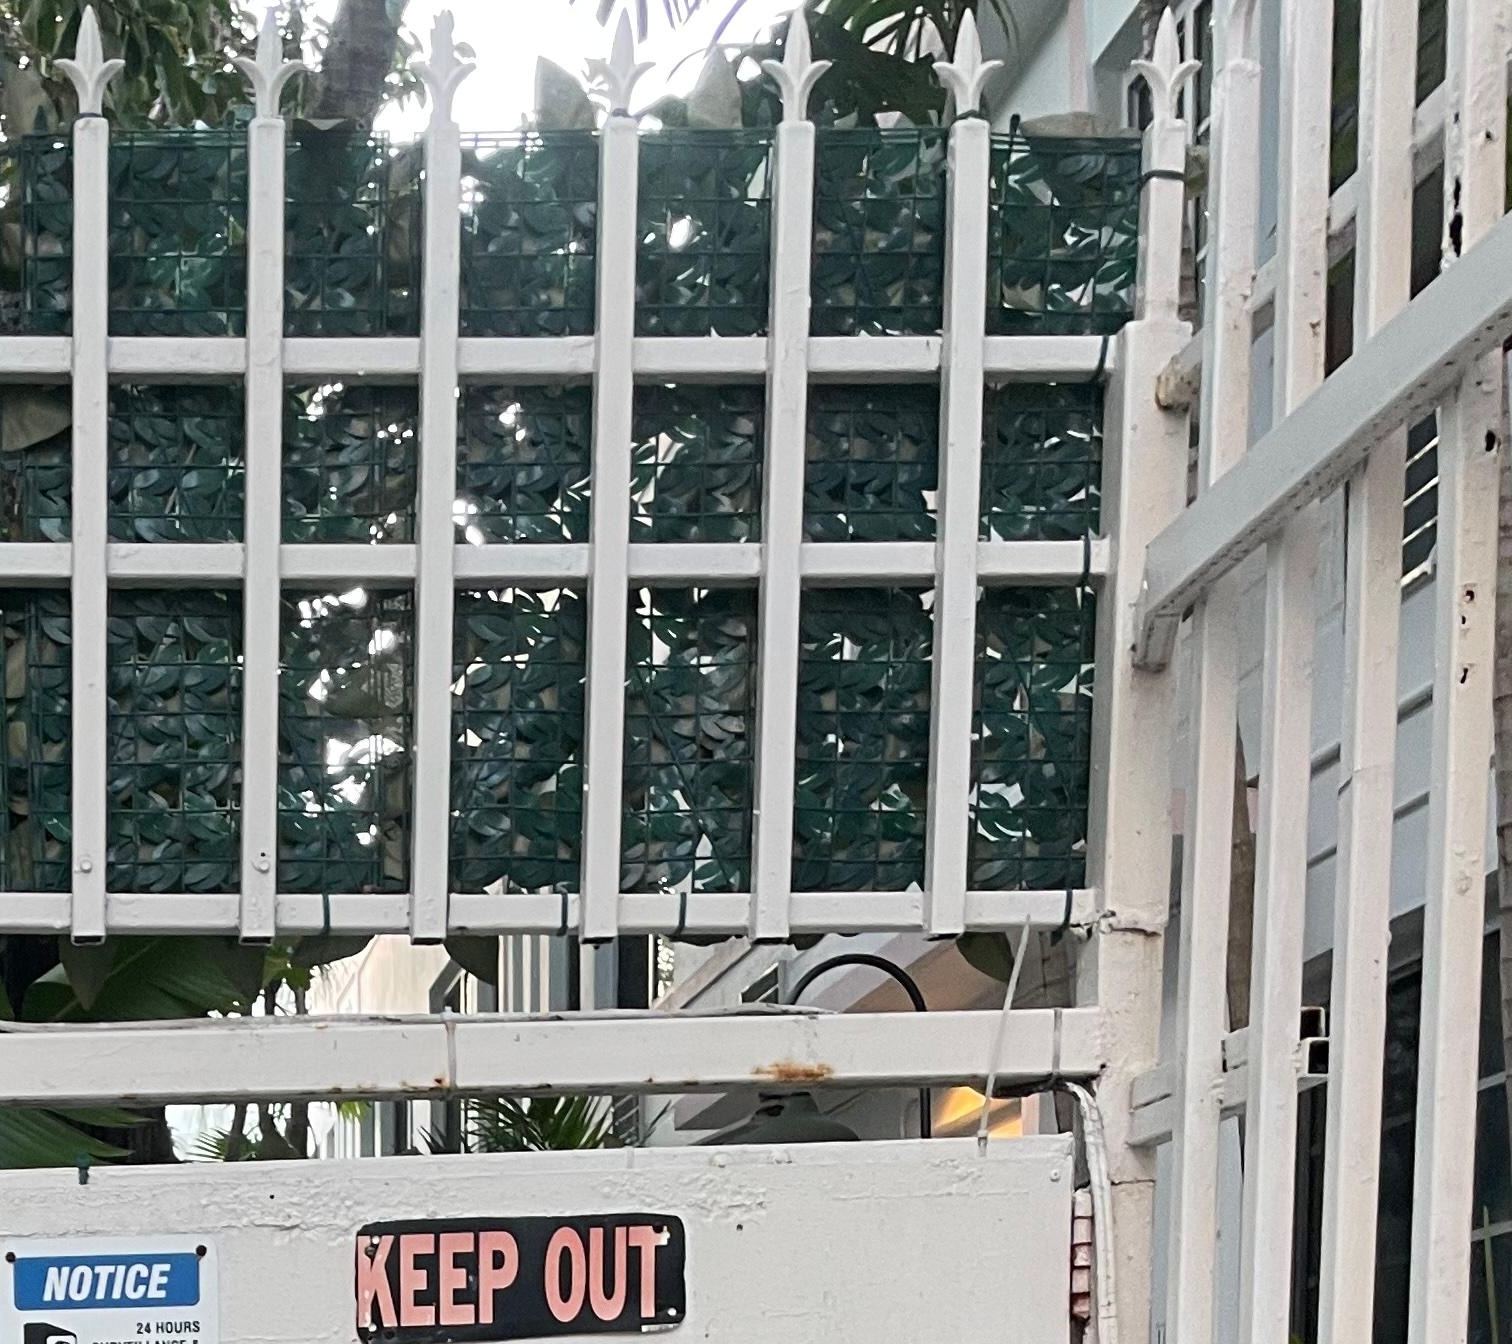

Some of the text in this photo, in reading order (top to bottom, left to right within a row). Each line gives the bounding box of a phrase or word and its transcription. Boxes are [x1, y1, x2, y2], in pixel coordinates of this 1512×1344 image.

[43, 1263, 171, 1302] NOTICE
[356, 1224, 670, 1329] KEEP OUT
[136, 1320, 201, 1335] 24 HOURS
